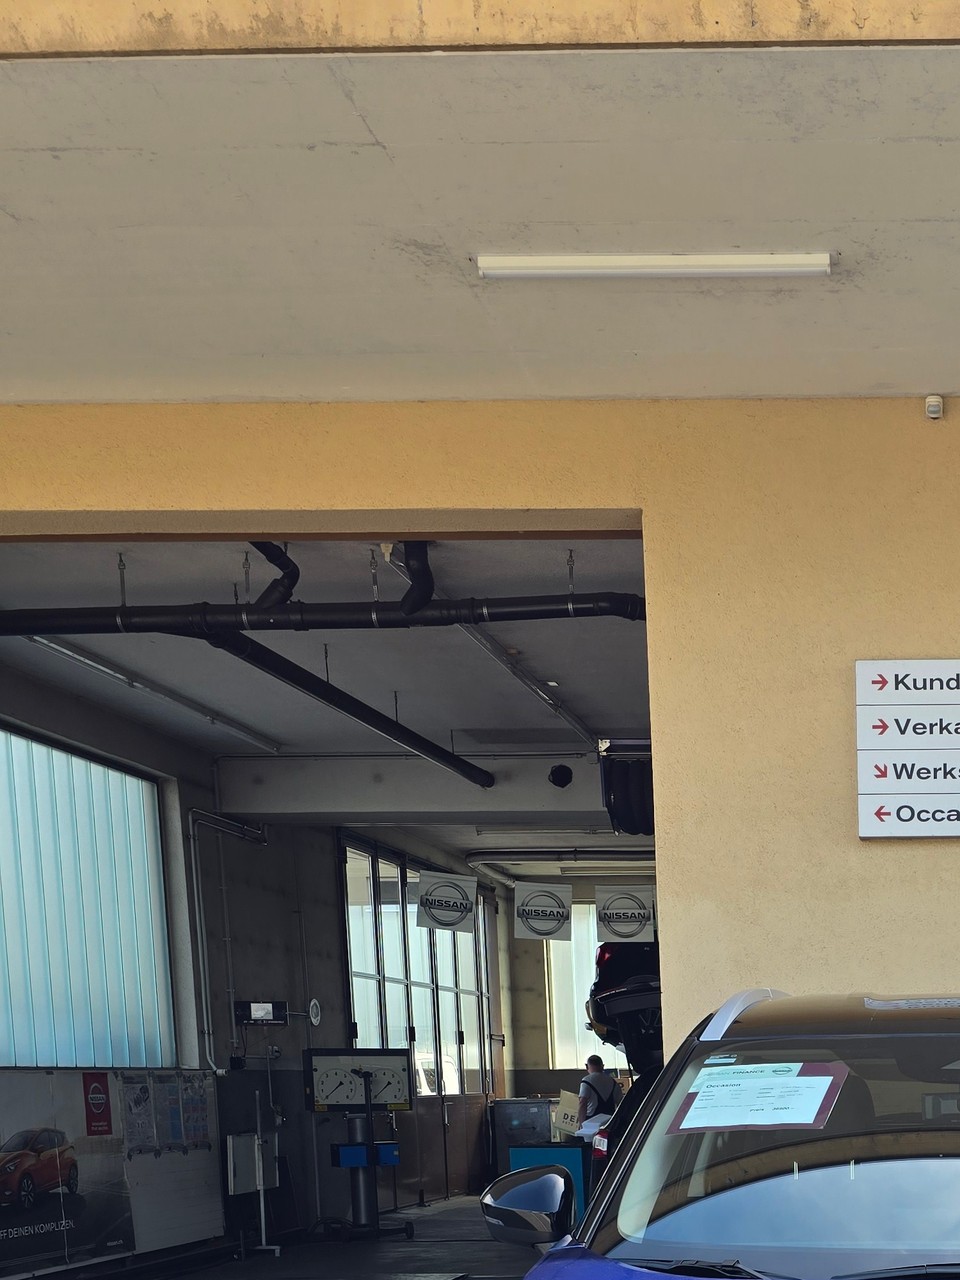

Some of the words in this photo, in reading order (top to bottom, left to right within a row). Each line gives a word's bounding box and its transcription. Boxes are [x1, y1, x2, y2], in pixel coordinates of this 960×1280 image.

[424, 897, 469, 910] NISSAN
[521, 907, 566, 918] NISSAN
[602, 911, 647, 921] NISSAN
[8, 1225, 34, 1239] DEINEN
